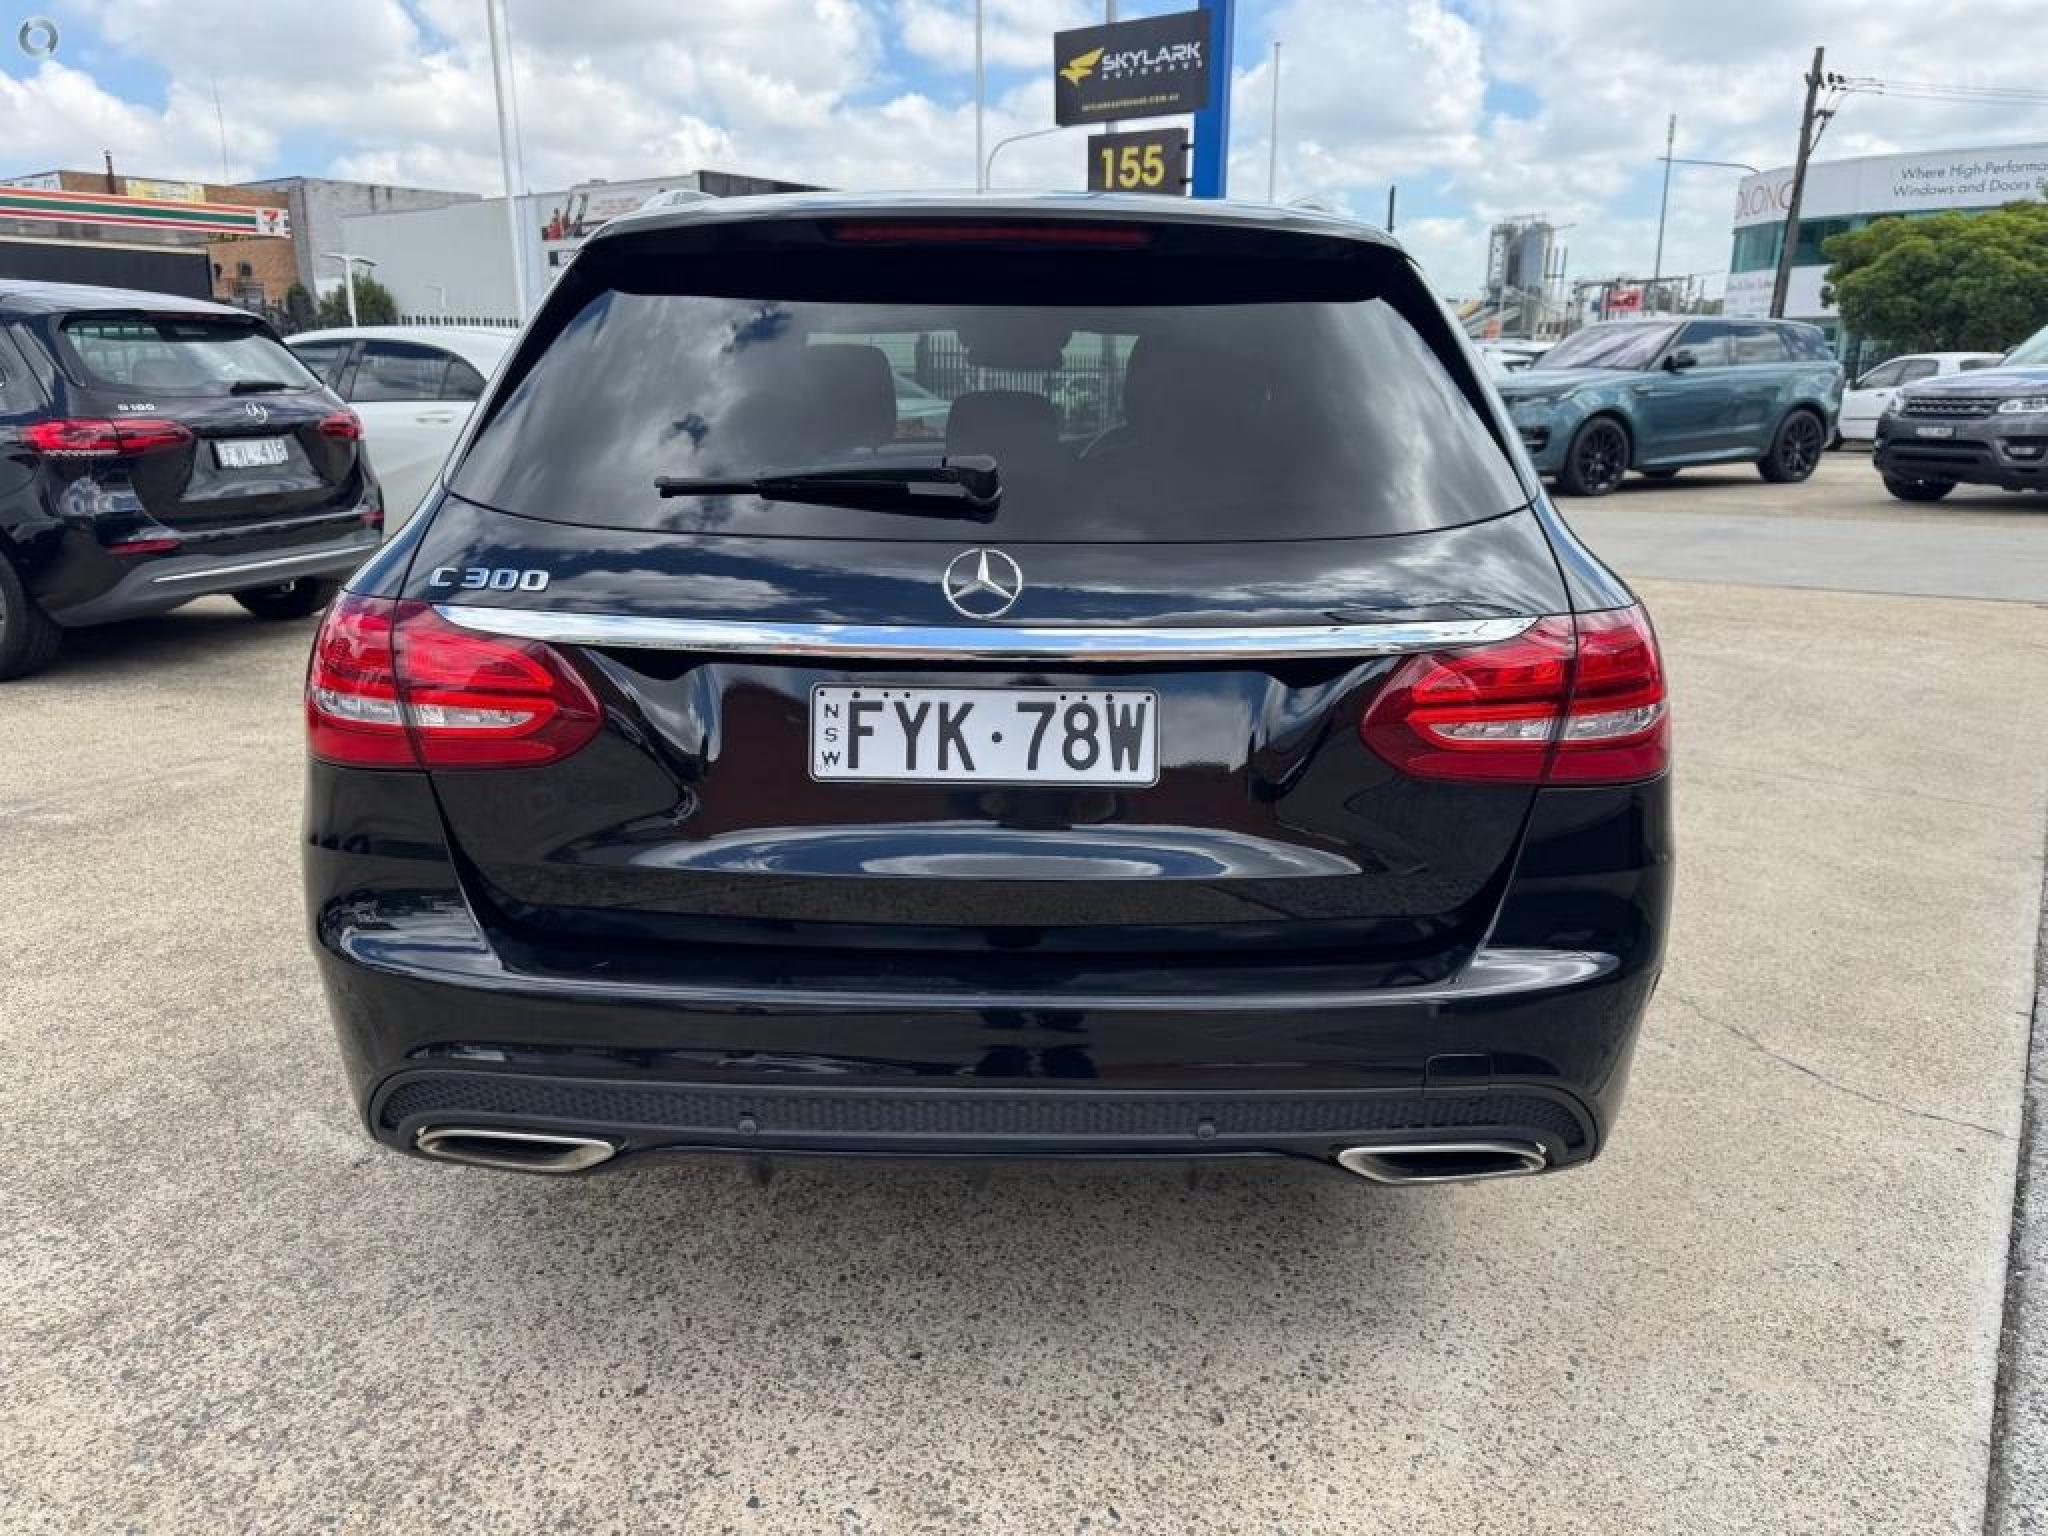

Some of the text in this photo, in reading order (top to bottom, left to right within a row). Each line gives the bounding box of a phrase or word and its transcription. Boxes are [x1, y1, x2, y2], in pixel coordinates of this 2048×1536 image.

[1102, 41, 1201, 71] SKYLARK
[1100, 143, 1165, 189] 155
[1901, 167, 1945, 179] Where
[1894, 184, 1953, 197] Windows
[1958, 182, 1985, 193] and
[1989, 179, 2030, 192] Doors
[429, 567, 550, 591] C 300
[821, 703, 841, 767] NSW
